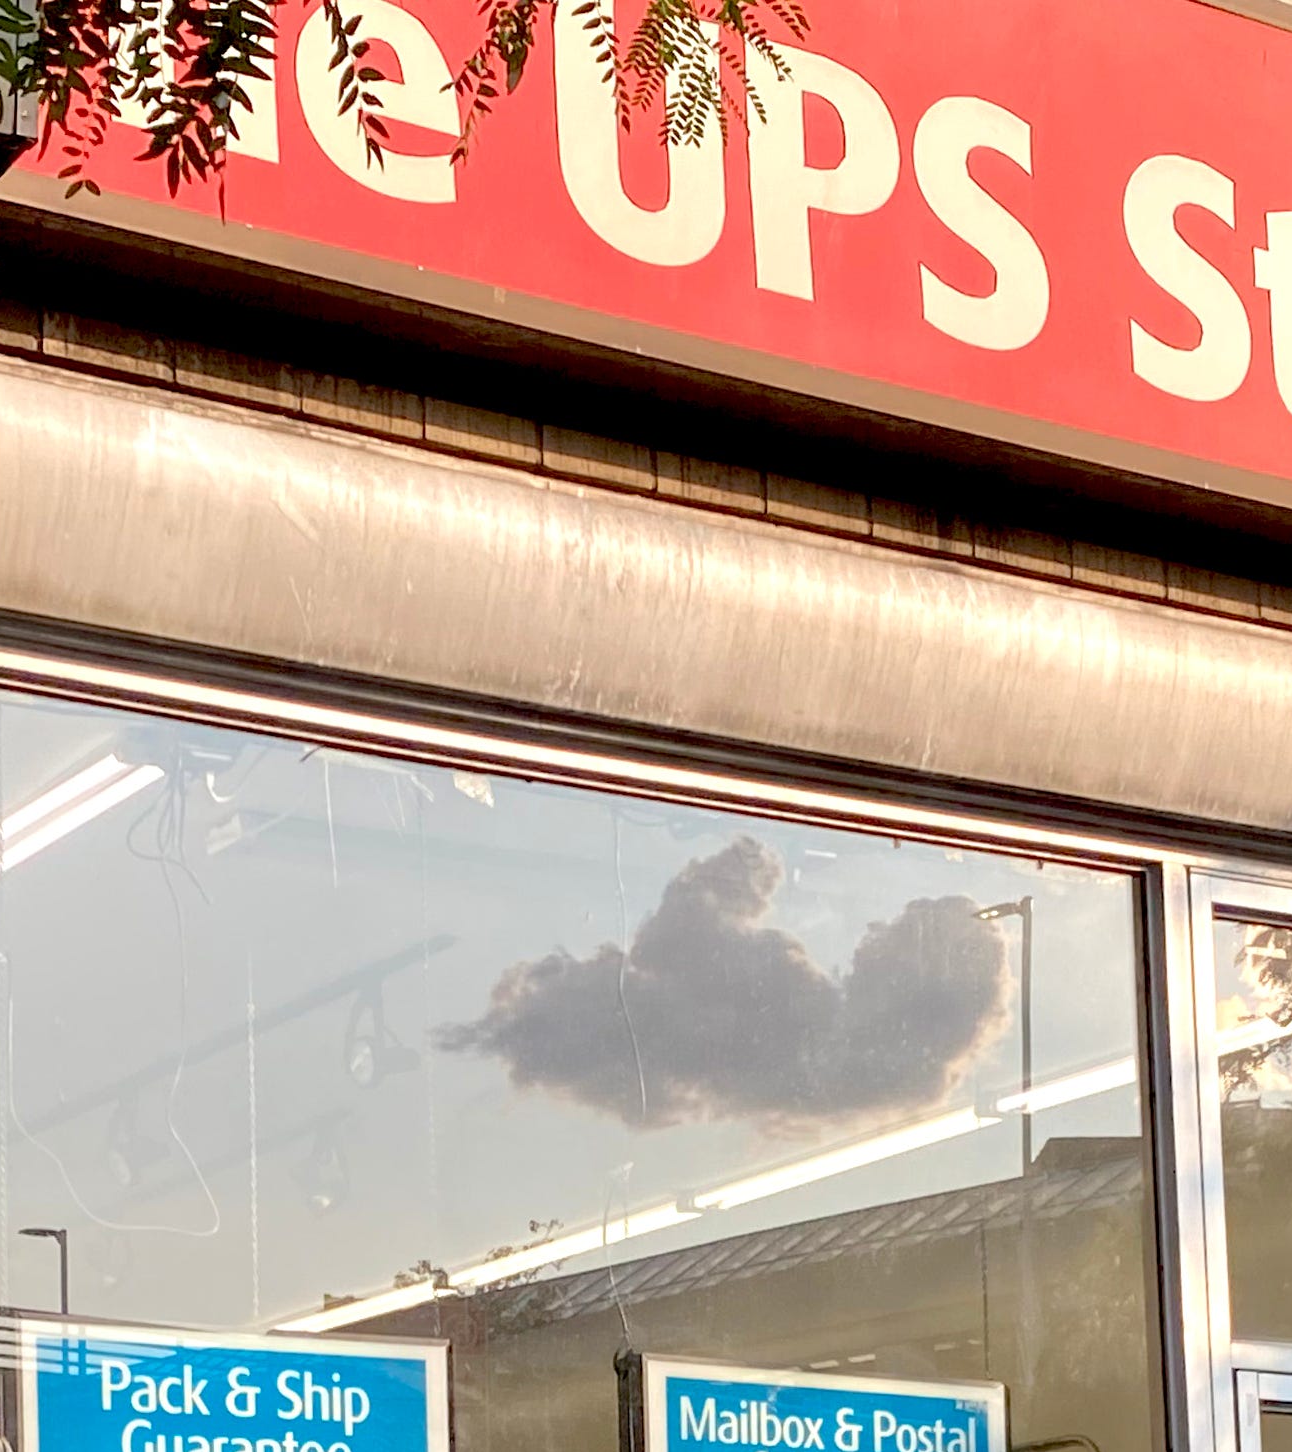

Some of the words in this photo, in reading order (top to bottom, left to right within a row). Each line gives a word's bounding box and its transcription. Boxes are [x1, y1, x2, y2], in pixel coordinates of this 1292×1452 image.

[555, 0, 1050, 351] UPS
[100, 1358, 210, 1416] Pack
[225, 1366, 261, 1418] &
[276, 1369, 371, 1436] Ship
[679, 1395, 825, 1450] Mailbox
[834, 1407, 863, 1452] &
